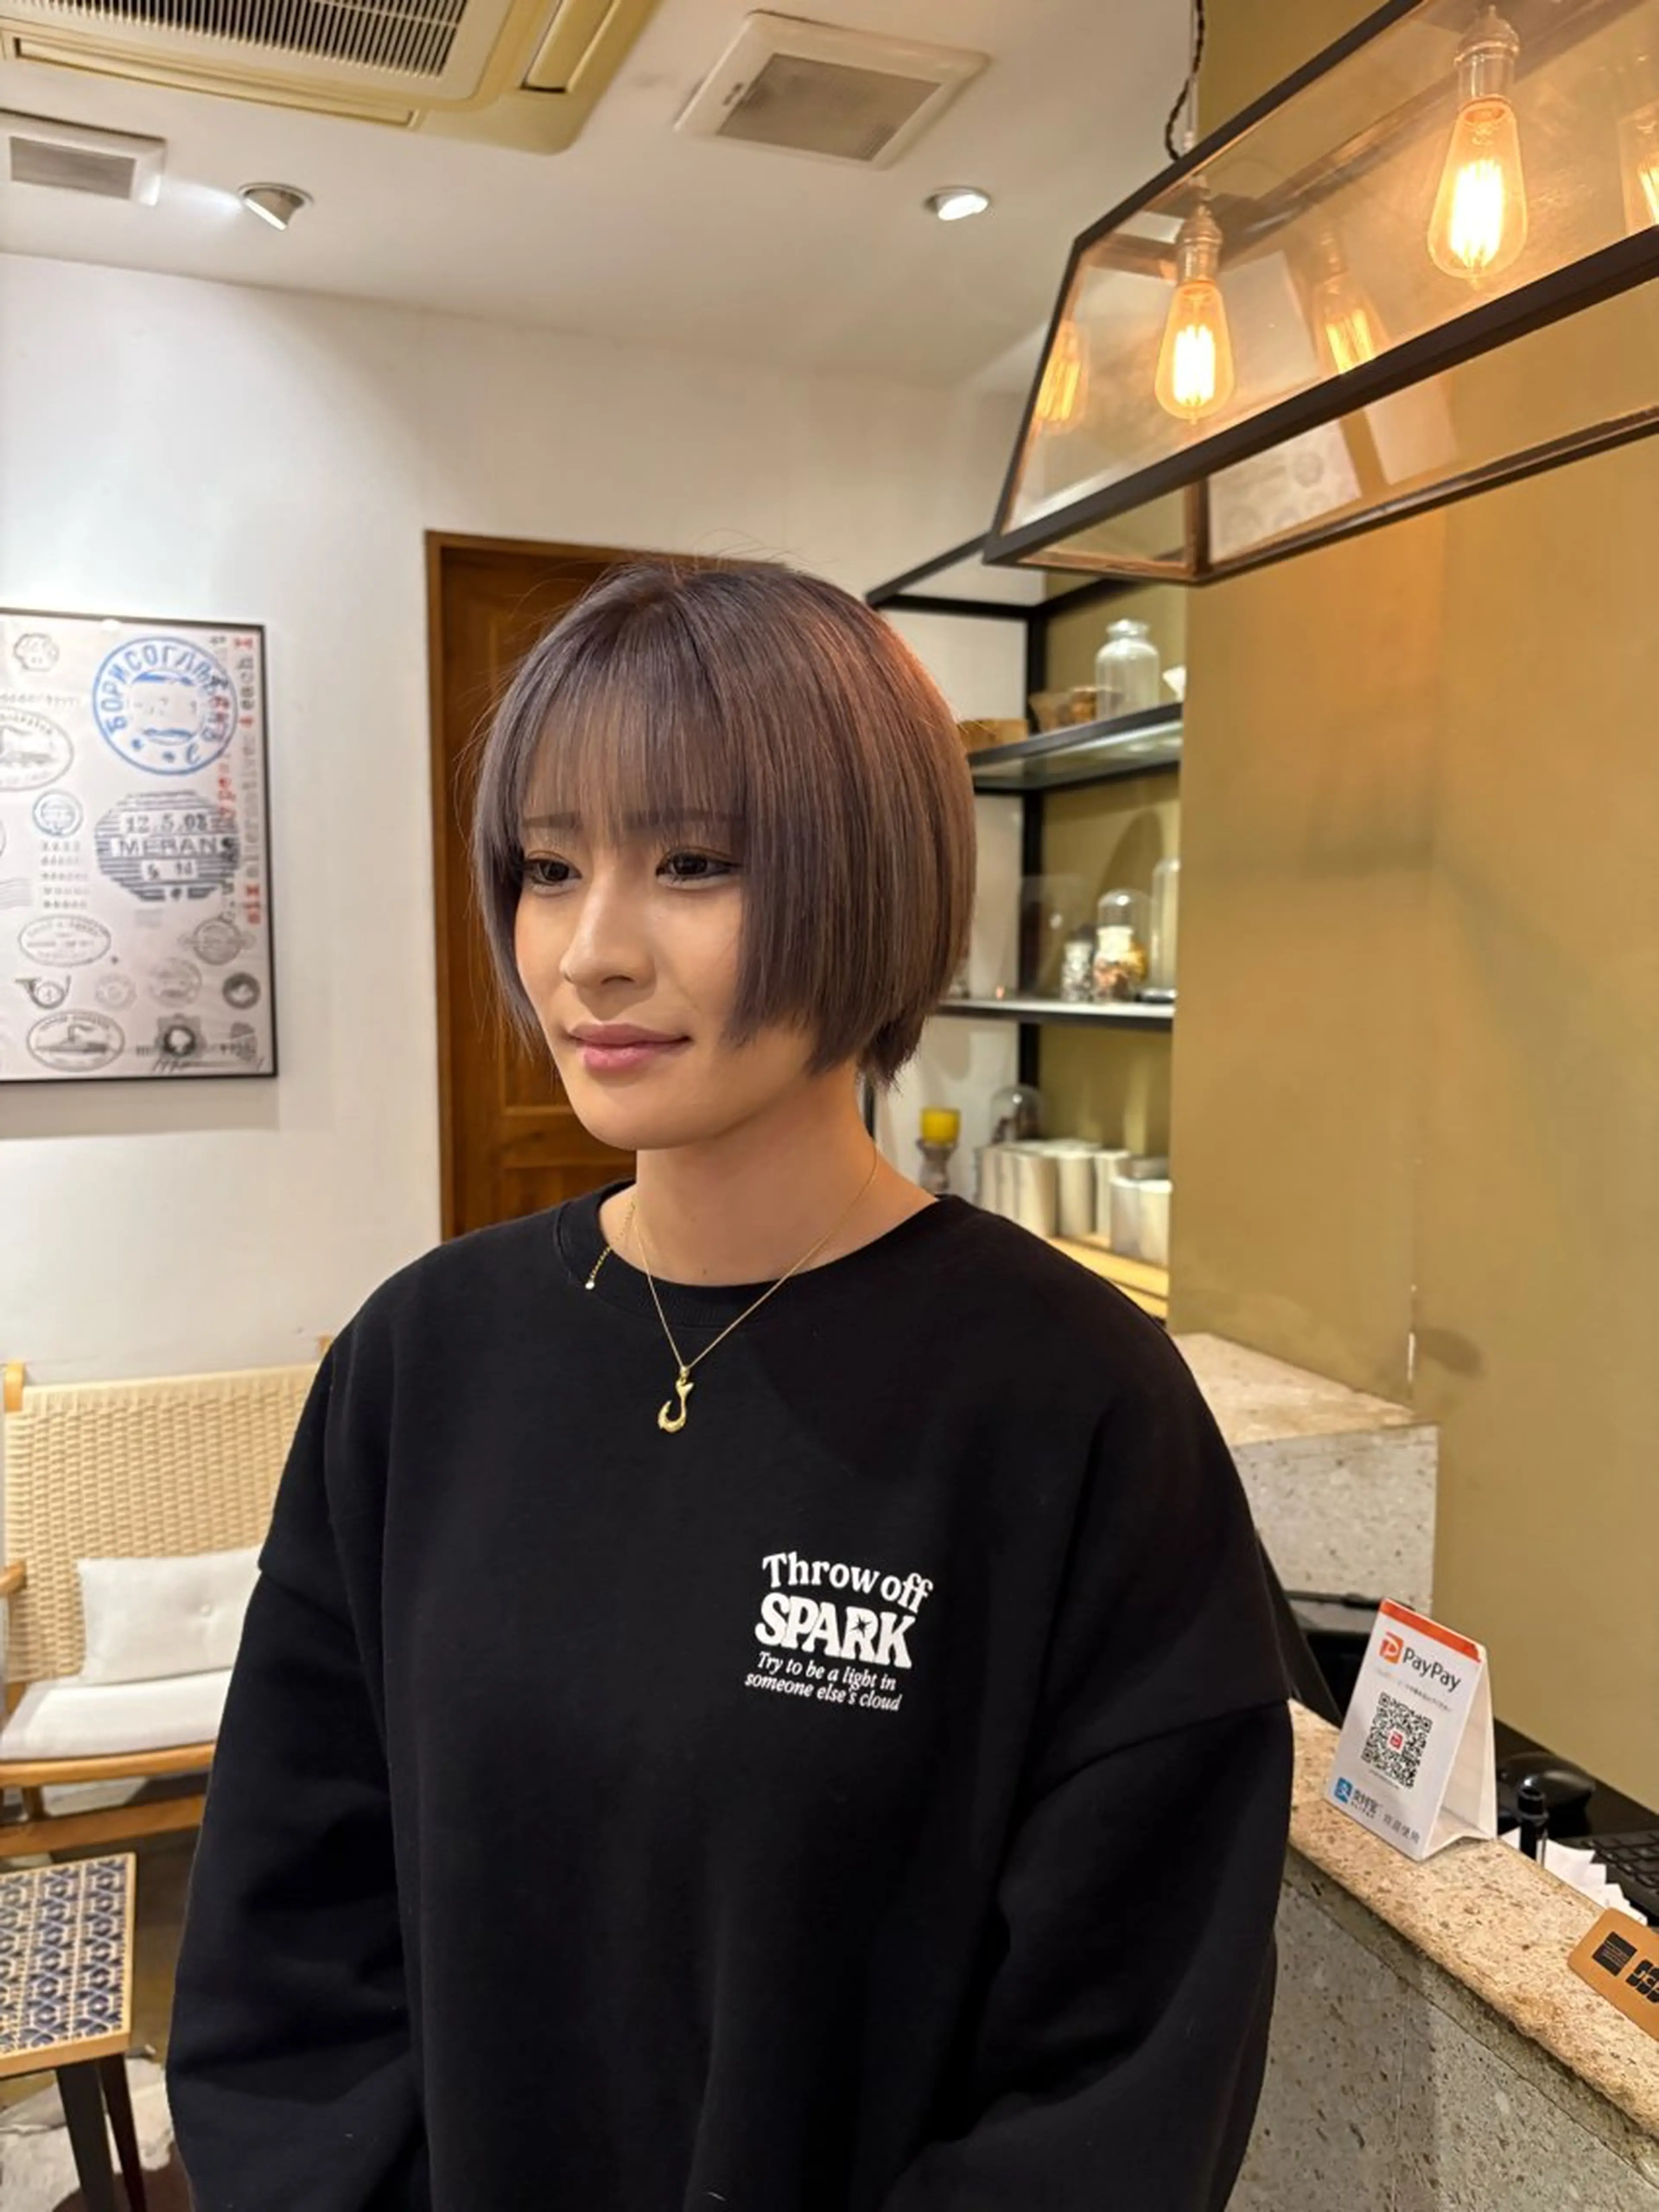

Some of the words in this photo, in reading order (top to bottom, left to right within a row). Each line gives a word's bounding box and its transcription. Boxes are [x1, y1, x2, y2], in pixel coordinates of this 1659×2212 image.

[762, 1551, 880, 1594] Throw
[880, 1573, 934, 1614] off
[755, 1592, 916, 1669] SPARK
[744, 1673, 814, 1698] someone
[817, 1683, 857, 1705] else's
[859, 1689, 903, 1711] cloud
[757, 1651, 783, 1675] Try
[785, 1659, 802, 1675] to
[806, 1659, 825, 1679] be
[827, 1668, 839, 1682] a
[842, 1666, 877, 1691] light
[880, 1674, 896, 1691] in
[1402, 1646, 1461, 1693] PayPay
